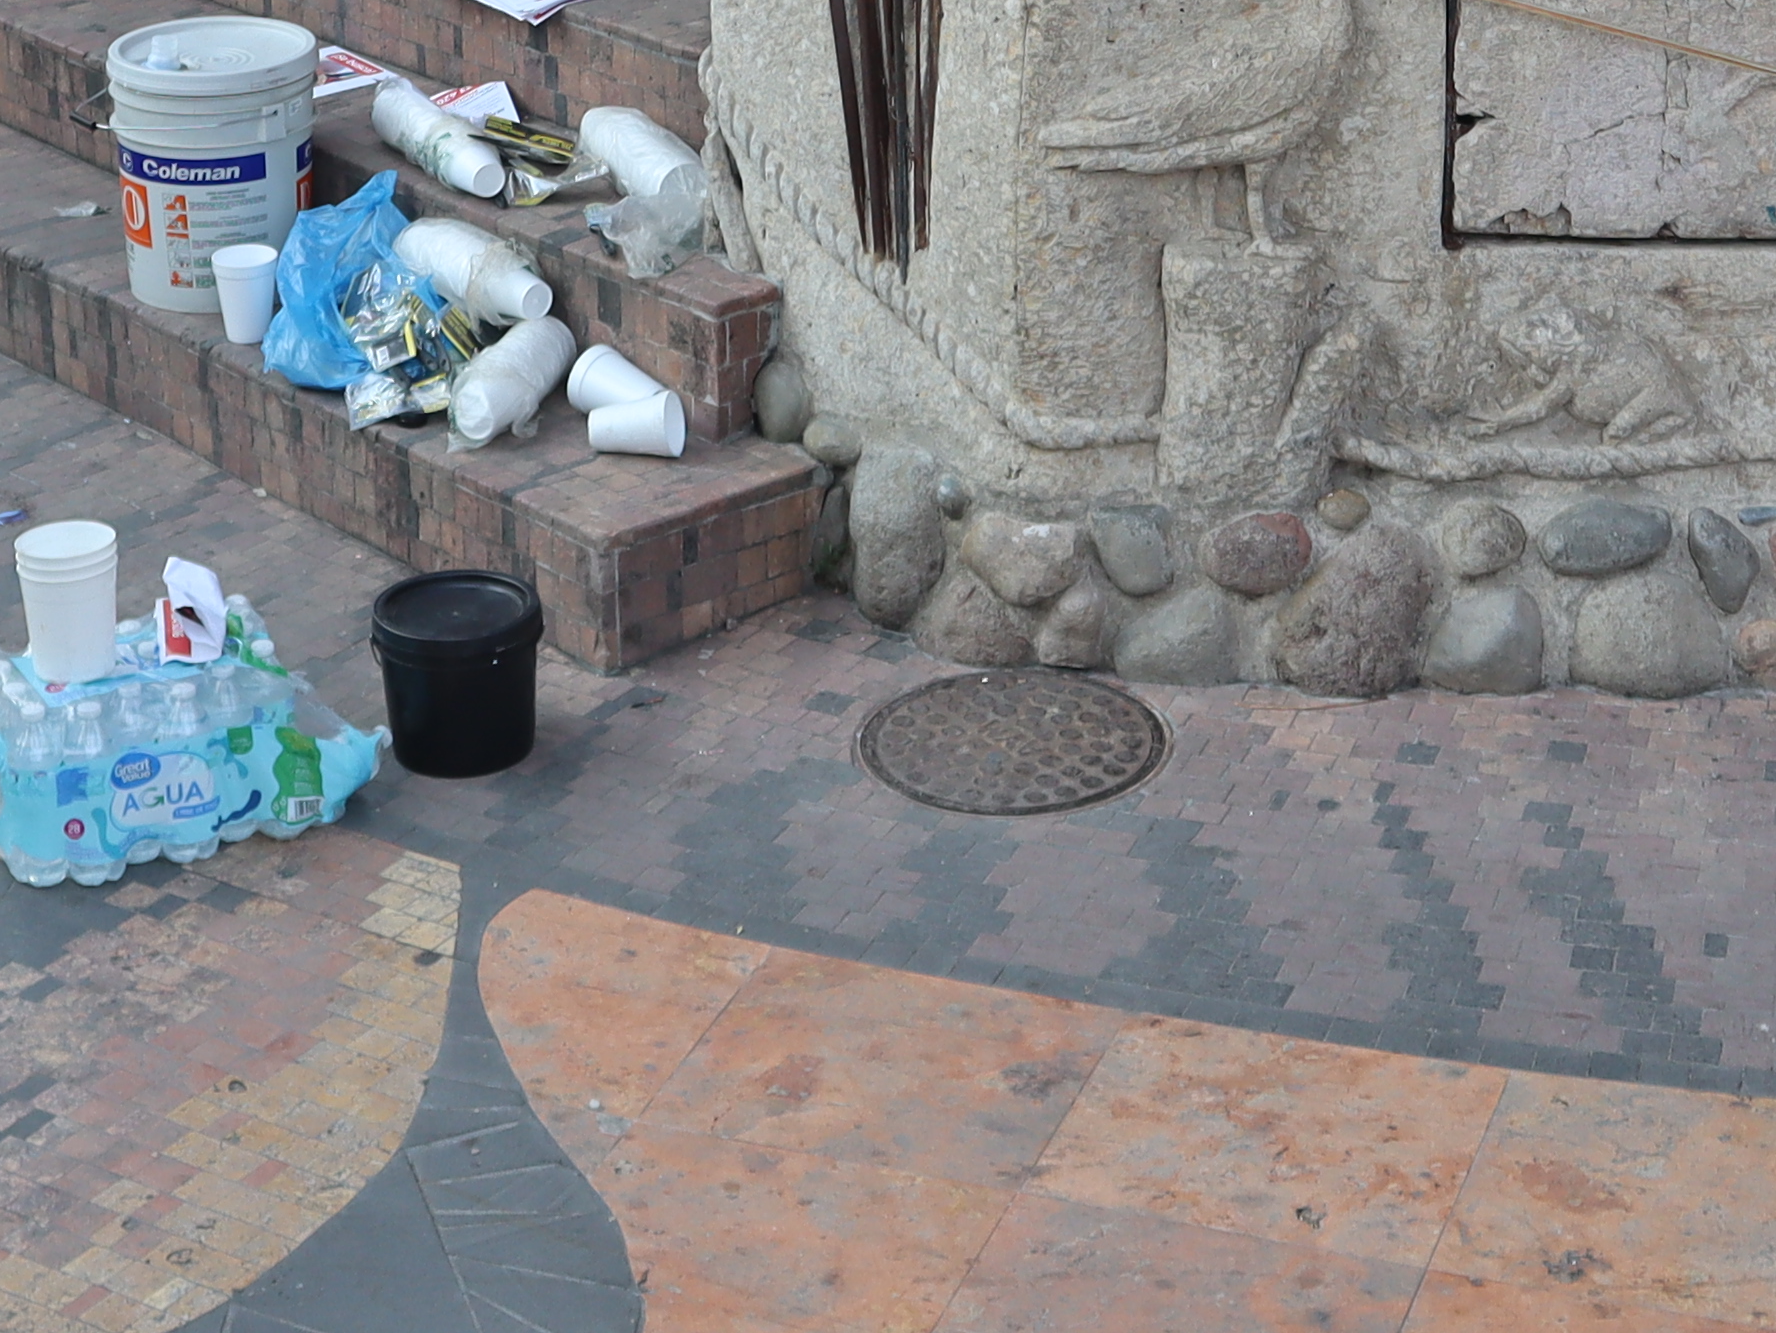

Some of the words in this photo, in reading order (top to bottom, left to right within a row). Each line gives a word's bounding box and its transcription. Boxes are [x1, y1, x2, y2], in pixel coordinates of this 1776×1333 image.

[142, 159, 241, 181] Coleman
[114, 759, 151, 778] Great
[123, 781, 205, 818] AGUA
[67, 823, 81, 835] 28
